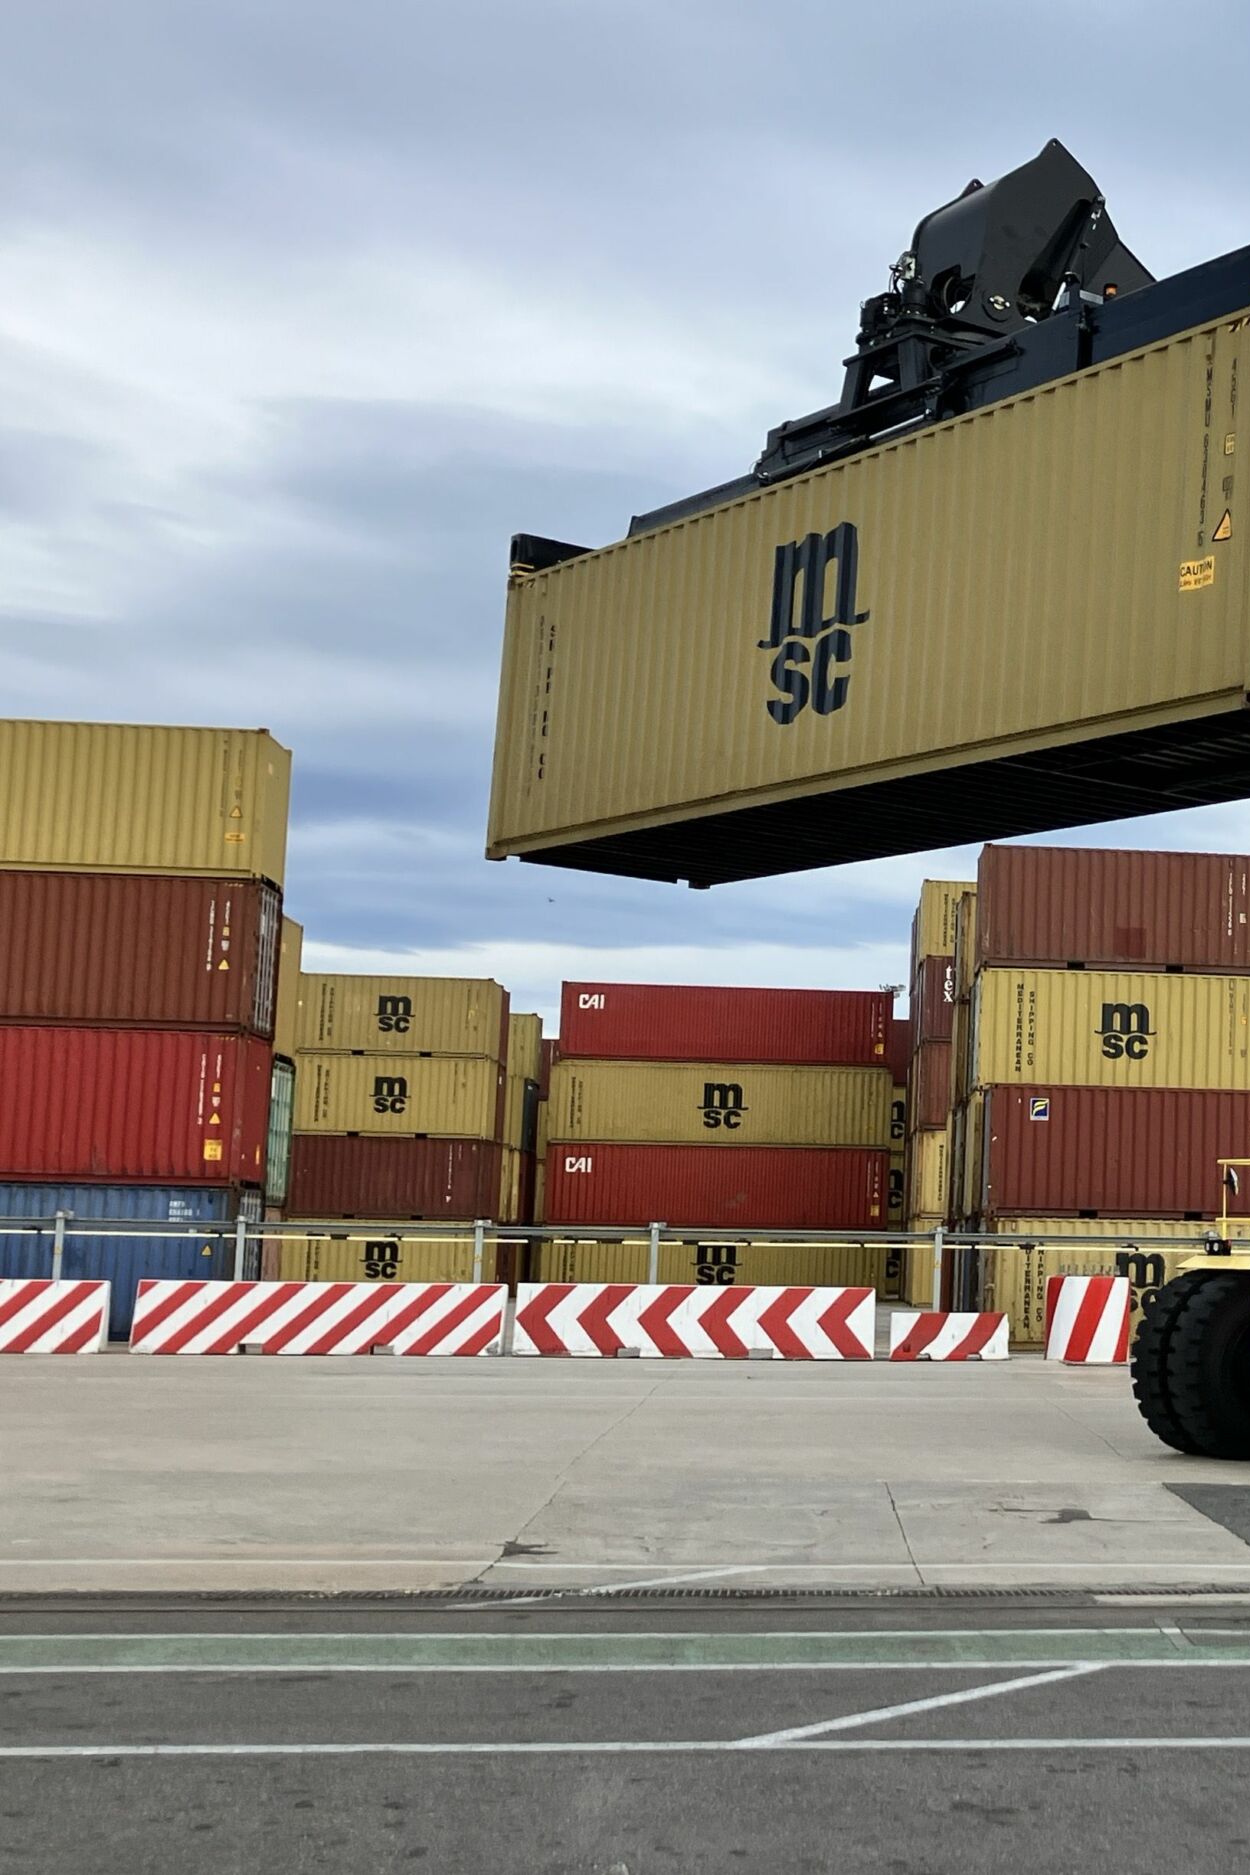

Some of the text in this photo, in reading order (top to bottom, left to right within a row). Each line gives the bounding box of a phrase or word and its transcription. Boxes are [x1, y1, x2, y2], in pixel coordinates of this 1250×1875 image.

[943, 965, 954, 1003] tex
[579, 993, 605, 1010] CAI
[1015, 984, 1024, 1073] MEDITERRANEAN
[1027, 1052, 1034, 1066] CO
[565, 1157, 592, 1174] CAI
[1037, 1249, 1045, 1300] HIPPING
